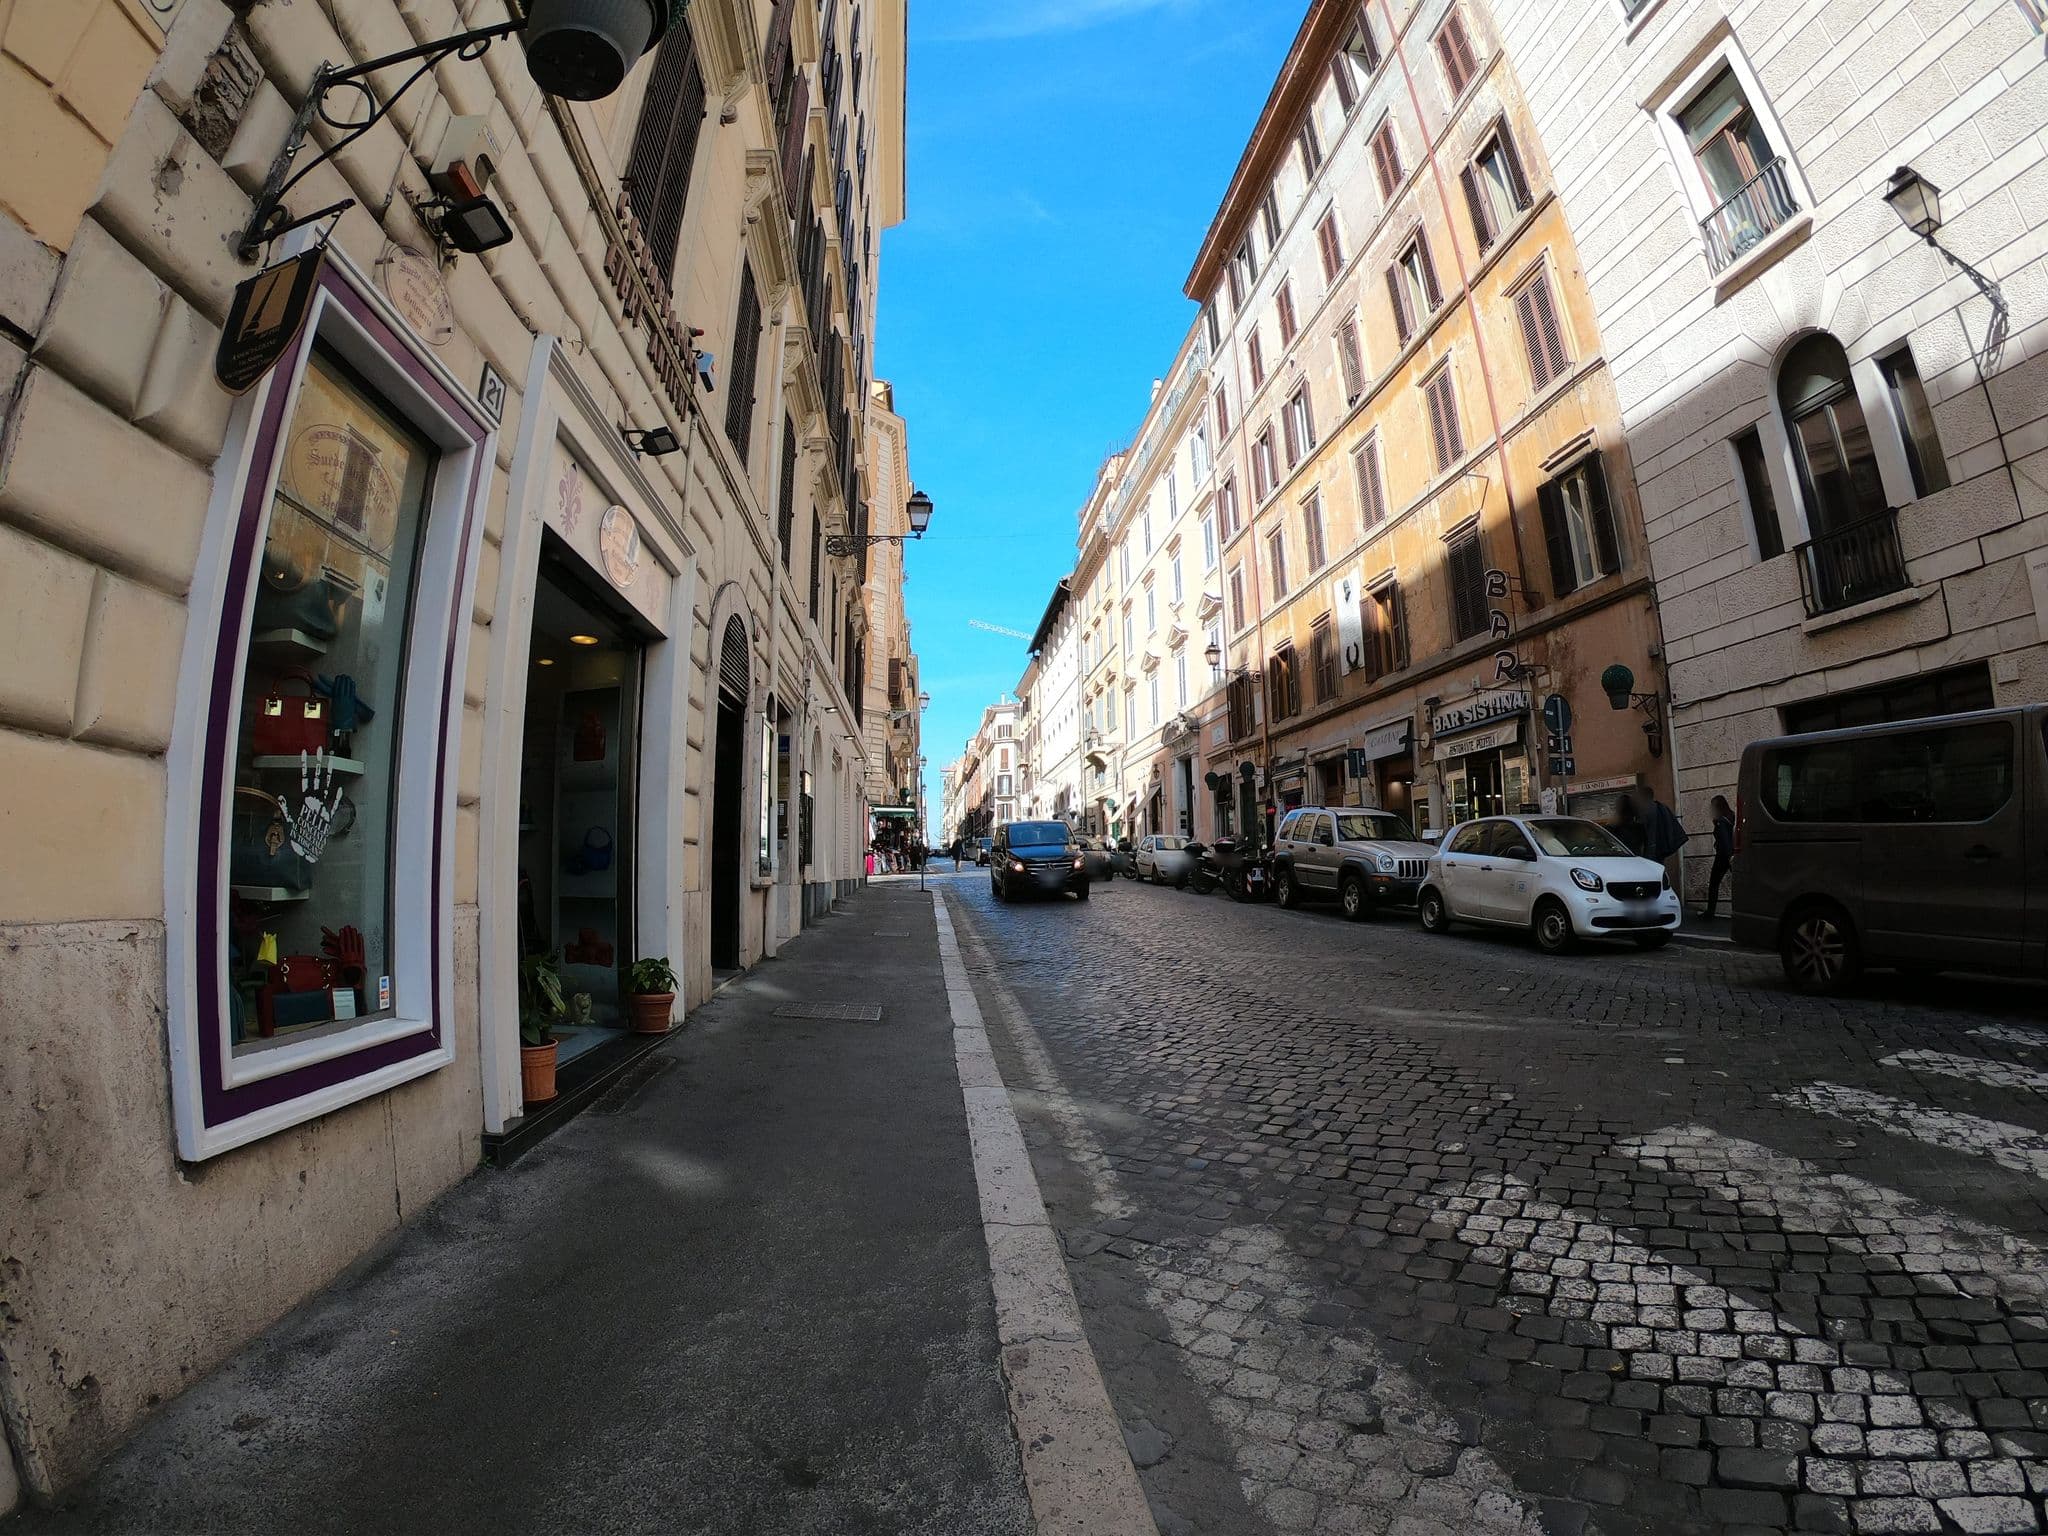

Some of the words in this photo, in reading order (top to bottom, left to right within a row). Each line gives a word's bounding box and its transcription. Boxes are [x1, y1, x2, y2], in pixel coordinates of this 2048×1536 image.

[604, 241, 647, 328] LIBRI
[486, 377, 502, 411] 21
[1484, 568, 1520, 682] BAR
[1432, 709, 1460, 734] BAR
